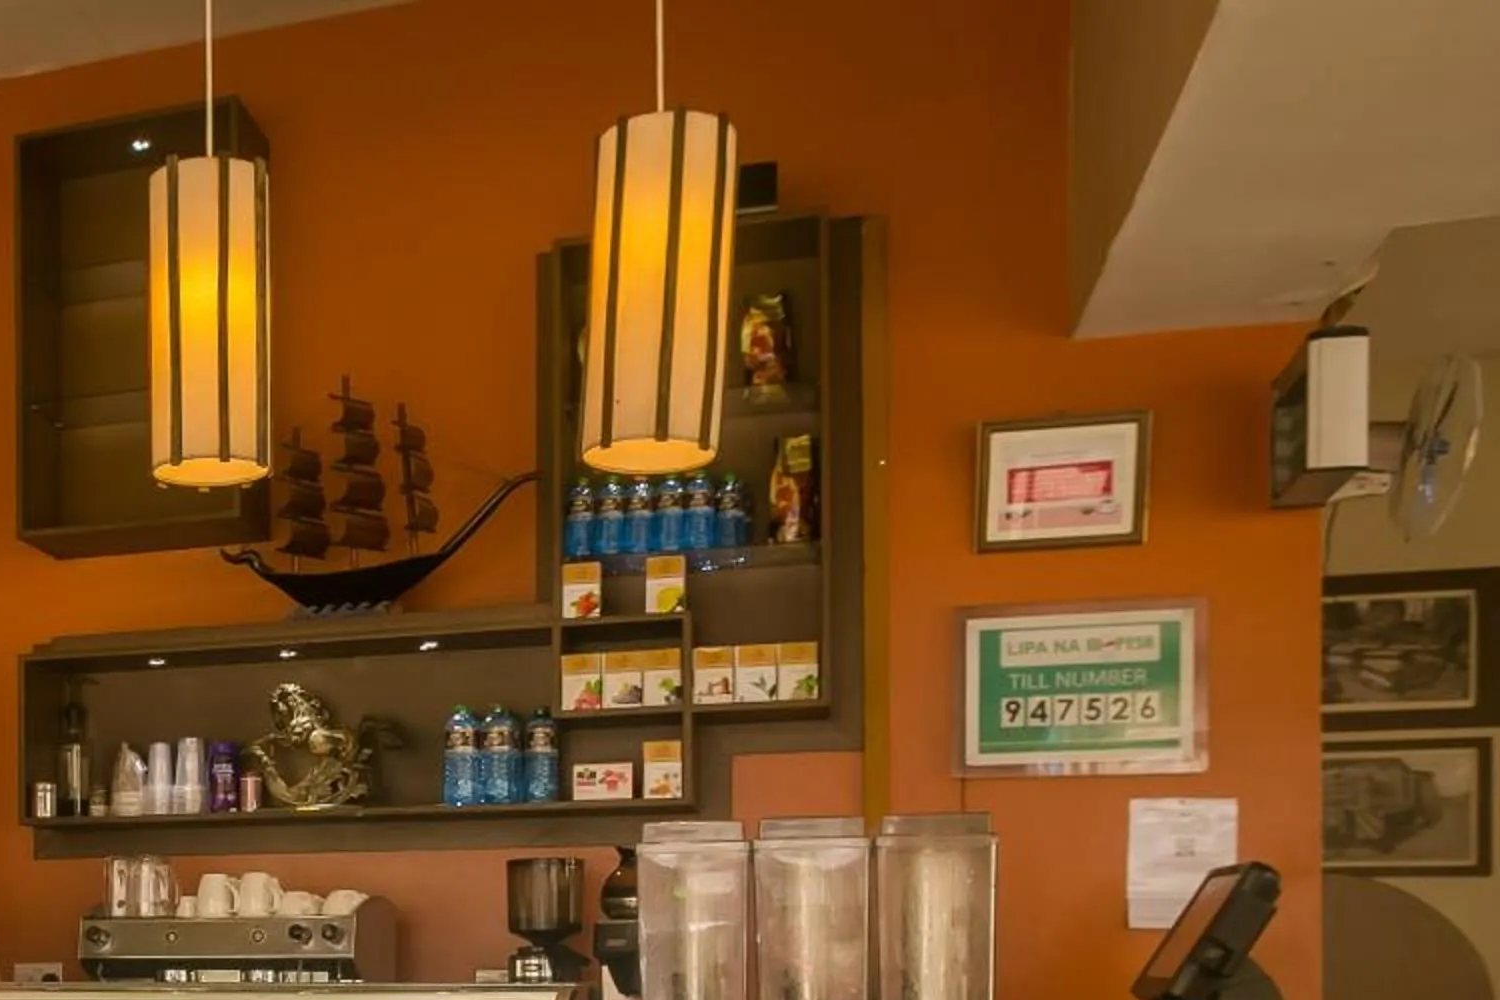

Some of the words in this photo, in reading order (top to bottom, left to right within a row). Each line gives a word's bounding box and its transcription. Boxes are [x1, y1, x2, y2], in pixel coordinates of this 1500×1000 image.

[1008, 641, 1047, 657] LIPA
[1053, 639, 1081, 655] NA
[1008, 673, 1050, 689] TILL
[1055, 668, 1148, 689] NUMBER
[1005, 697, 1157, 723] 947526
